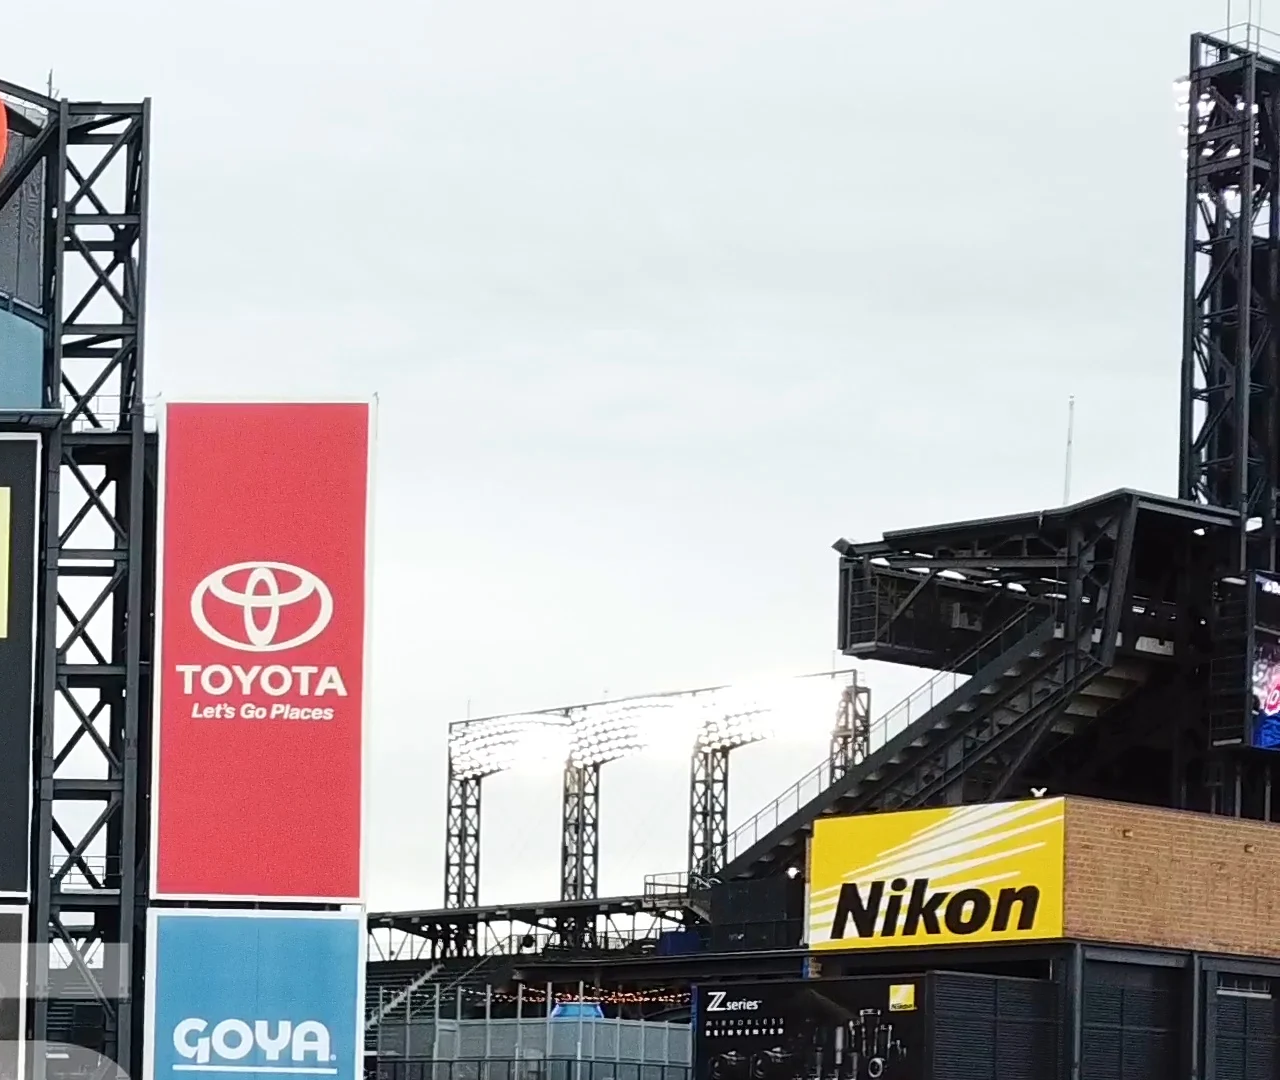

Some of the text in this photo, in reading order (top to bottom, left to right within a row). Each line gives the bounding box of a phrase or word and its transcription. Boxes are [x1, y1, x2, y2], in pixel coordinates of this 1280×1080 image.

[176, 664, 348, 696] TOYOTA
[192, 703, 334, 720] Let's Go Places
[830, 878, 1041, 939] Nikon
[173, 1018, 330, 1064] GOYA
